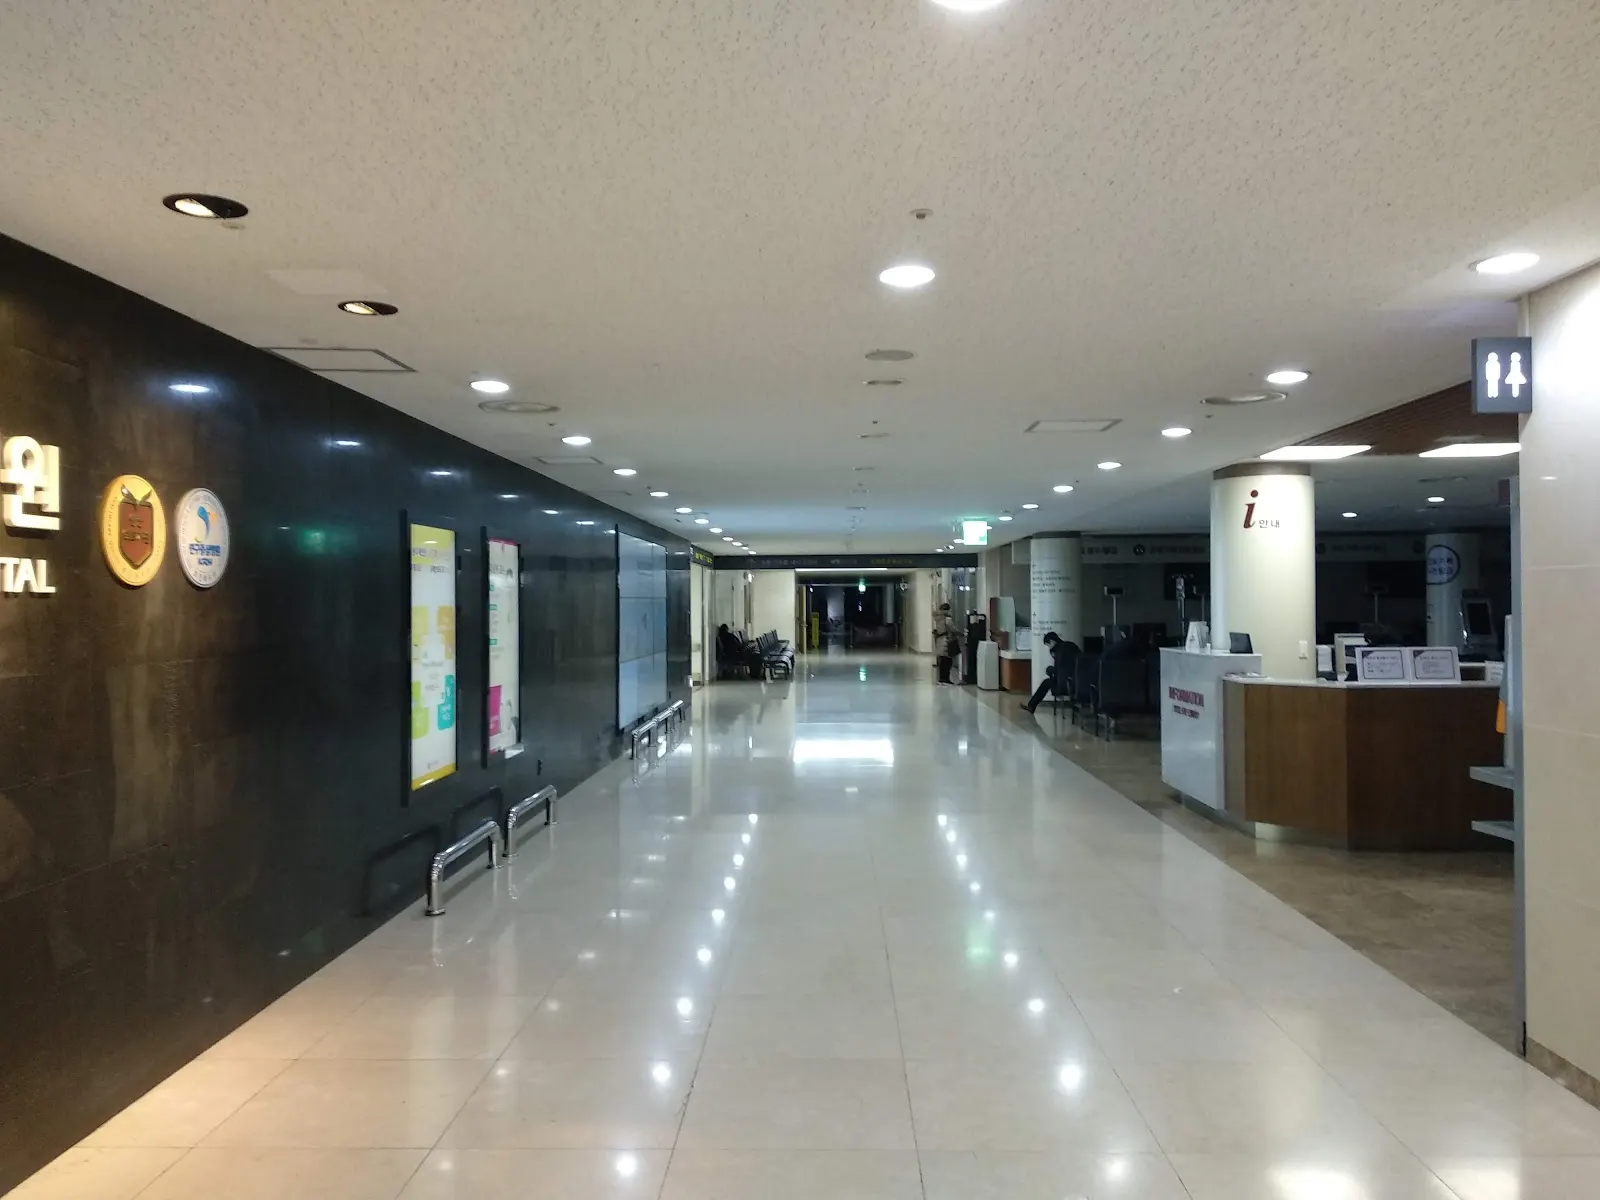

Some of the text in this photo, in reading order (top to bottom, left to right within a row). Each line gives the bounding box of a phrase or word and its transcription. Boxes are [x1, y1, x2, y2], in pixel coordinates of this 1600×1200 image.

[0, 436, 61, 531] 원
[1259, 519, 1280, 529] 안내
[0, 557, 57, 594] TAL
